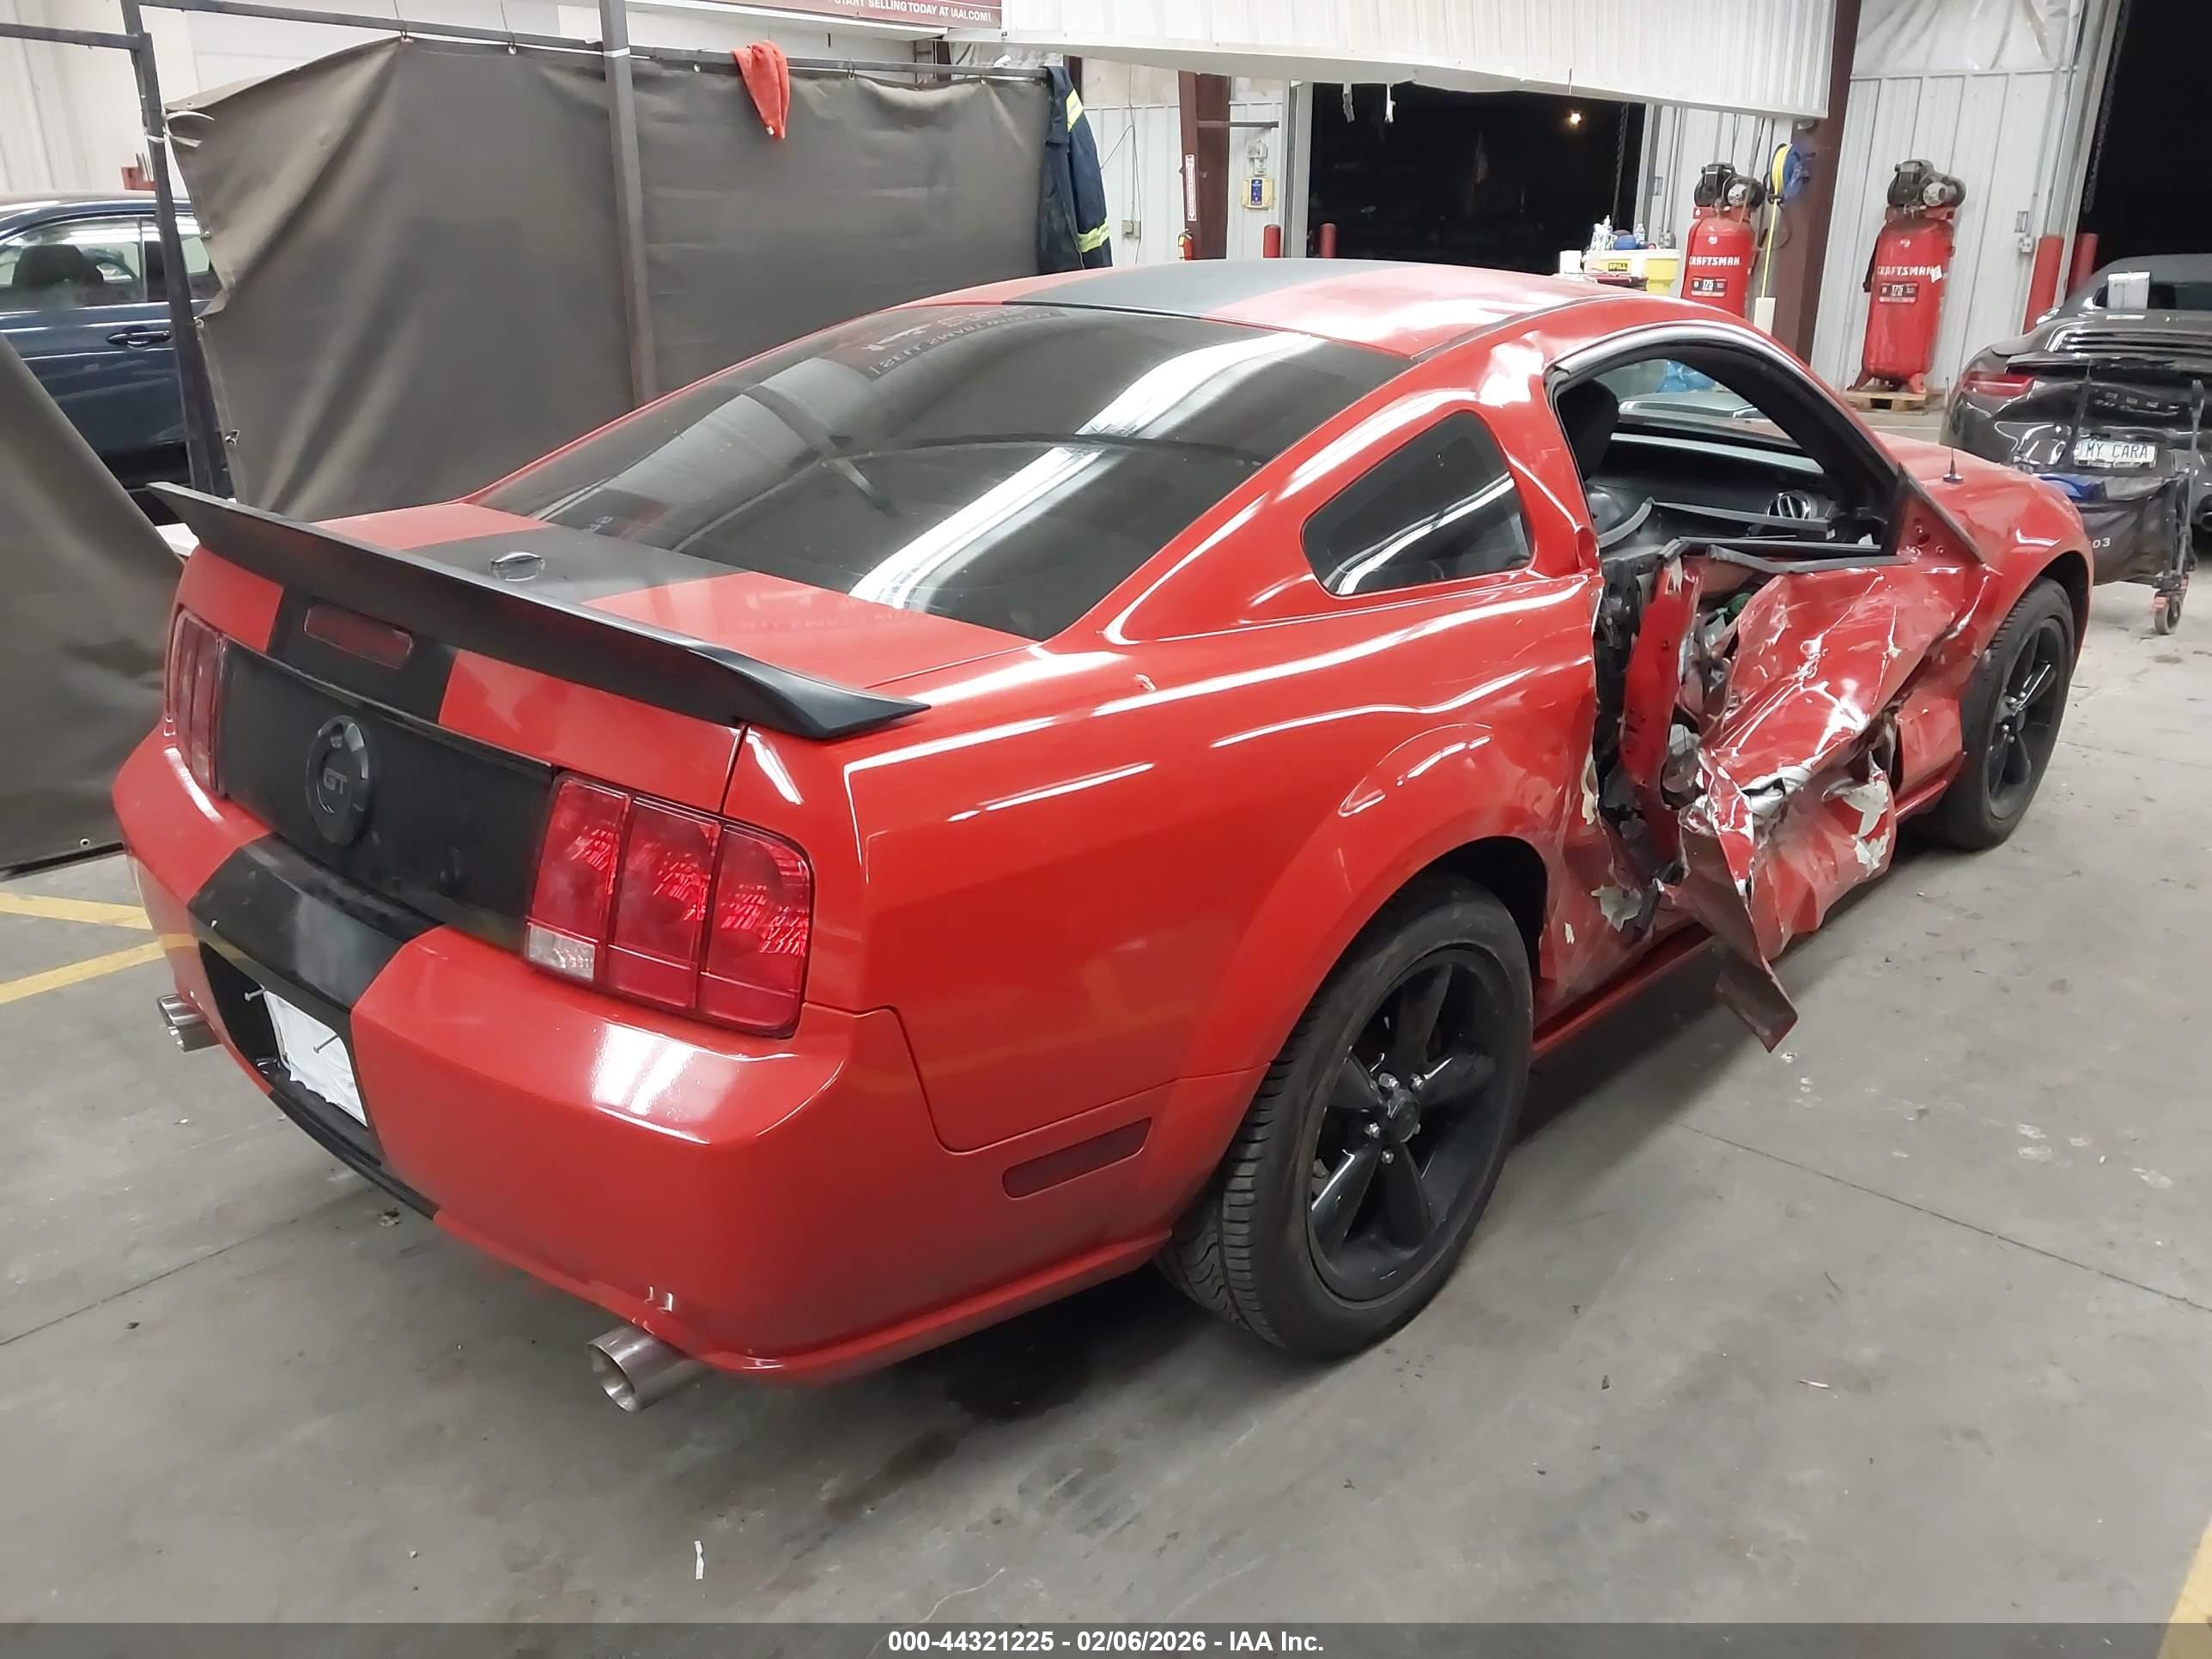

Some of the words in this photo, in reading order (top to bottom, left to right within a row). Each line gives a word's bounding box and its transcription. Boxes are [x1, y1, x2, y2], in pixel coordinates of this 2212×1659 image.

[868, 0, 908, 12] SELLING
[908, 2, 938, 15] TODAY
[939, 6, 949, 16] AT
[1688, 256, 1741, 266] CRAFTSMAN
[2086, 442, 2104, 458] MY
[323, 768, 348, 794] GT
